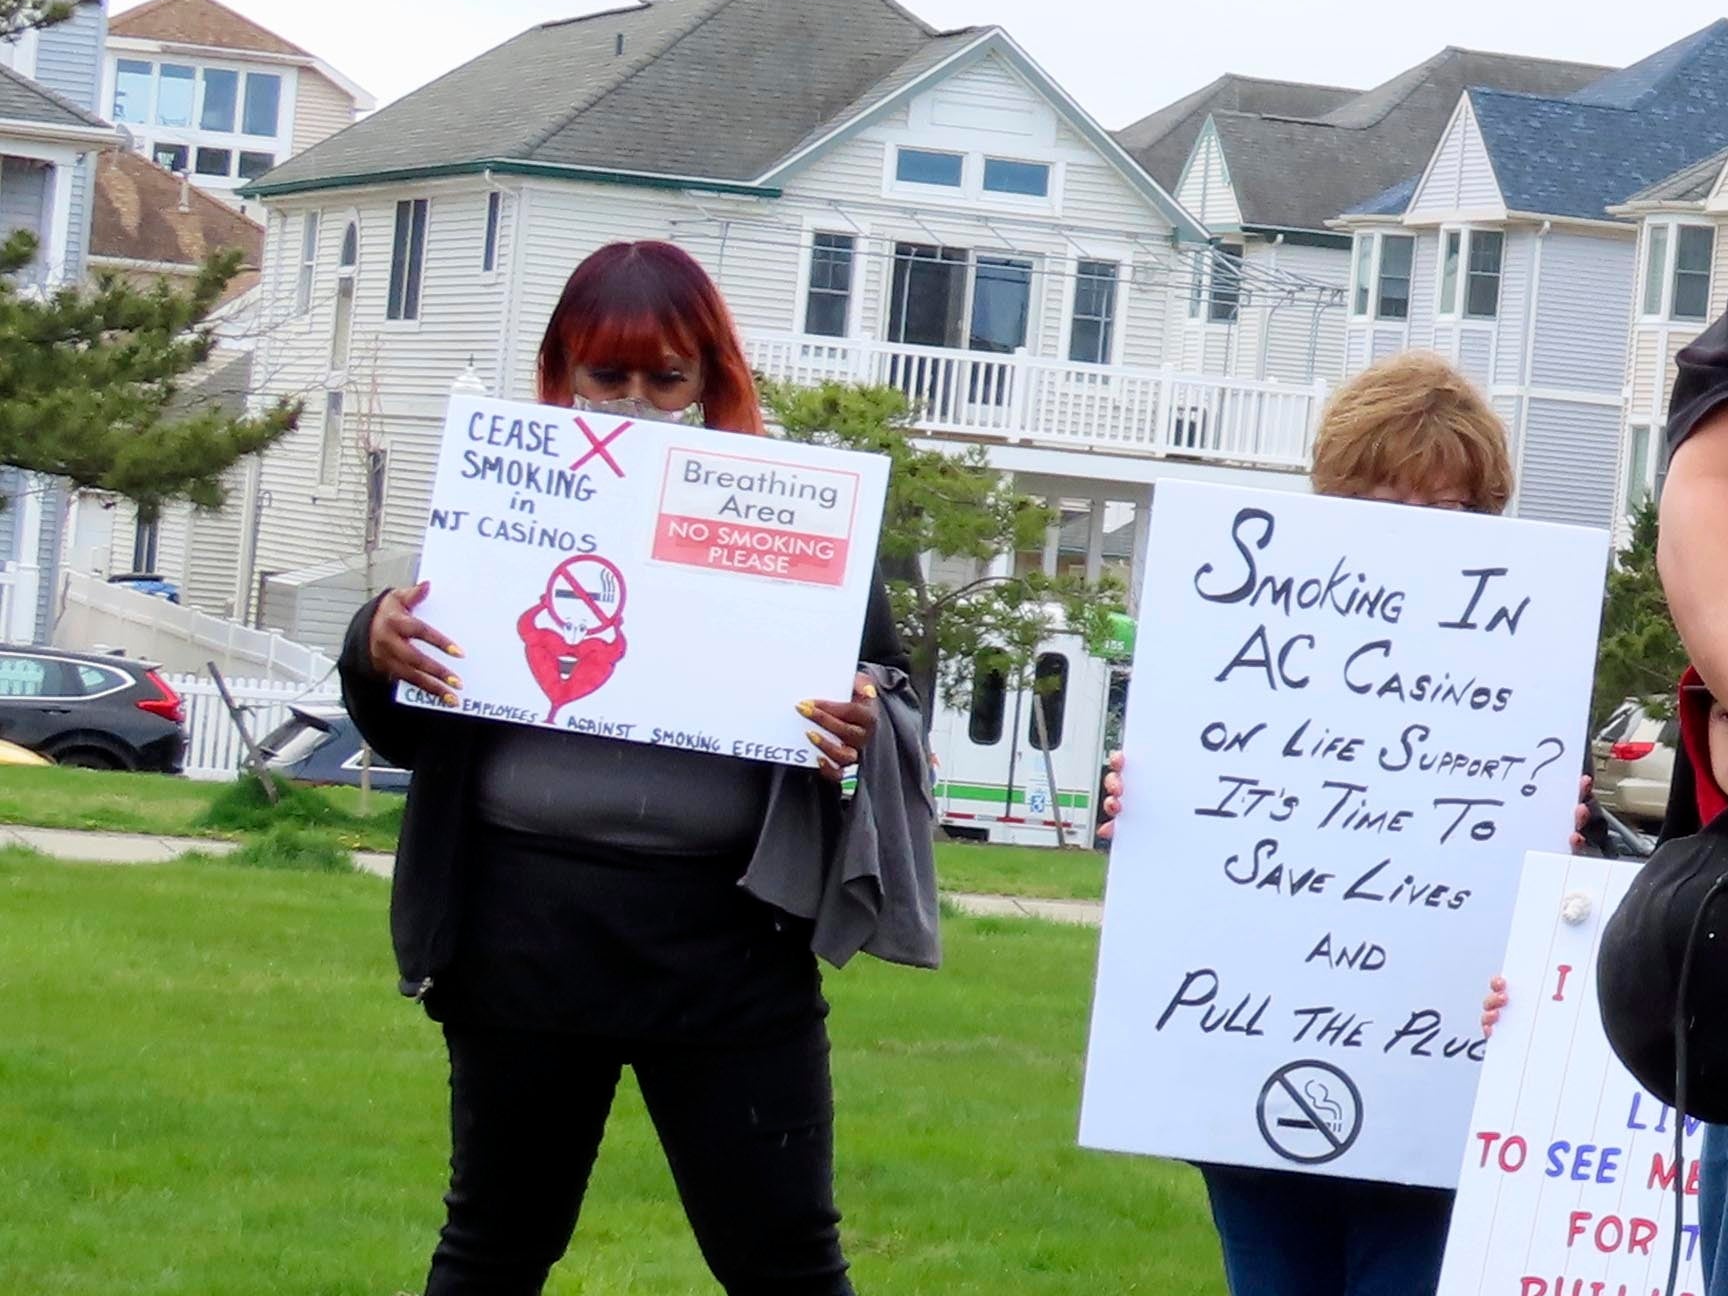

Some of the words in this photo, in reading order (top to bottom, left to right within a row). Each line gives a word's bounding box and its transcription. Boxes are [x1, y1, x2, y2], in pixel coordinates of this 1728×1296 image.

[467, 411, 560, 458] CEASE
[461, 450, 597, 502] SMOKING
[683, 458, 839, 510] Breathing
[430, 509, 468, 533] NJ
[509, 492, 536, 515] in
[719, 495, 795, 526] Area
[668, 521, 710, 545] NO
[715, 525, 836, 561] SMOKING
[708, 547, 791, 575] PLEASE
[1214, 625, 1316, 691] AC
[462, 696, 537, 724] EMPLOYEES
[732, 740, 809, 764] EFFECTS
[1199, 720, 1268, 753] ON
[1379, 723, 1566, 797] SUPPORT?
[1433, 797, 1505, 845] TO
[1223, 838, 1335, 897] SAVE
[1304, 932, 1387, 973] AND
[1155, 968, 1273, 1039] PULL
[1293, 1005, 1374, 1049] THE
[1477, 1131, 1528, 1173] TO
[1545, 1140, 1622, 1184] SEE
[1566, 1211, 1658, 1255] FOR
